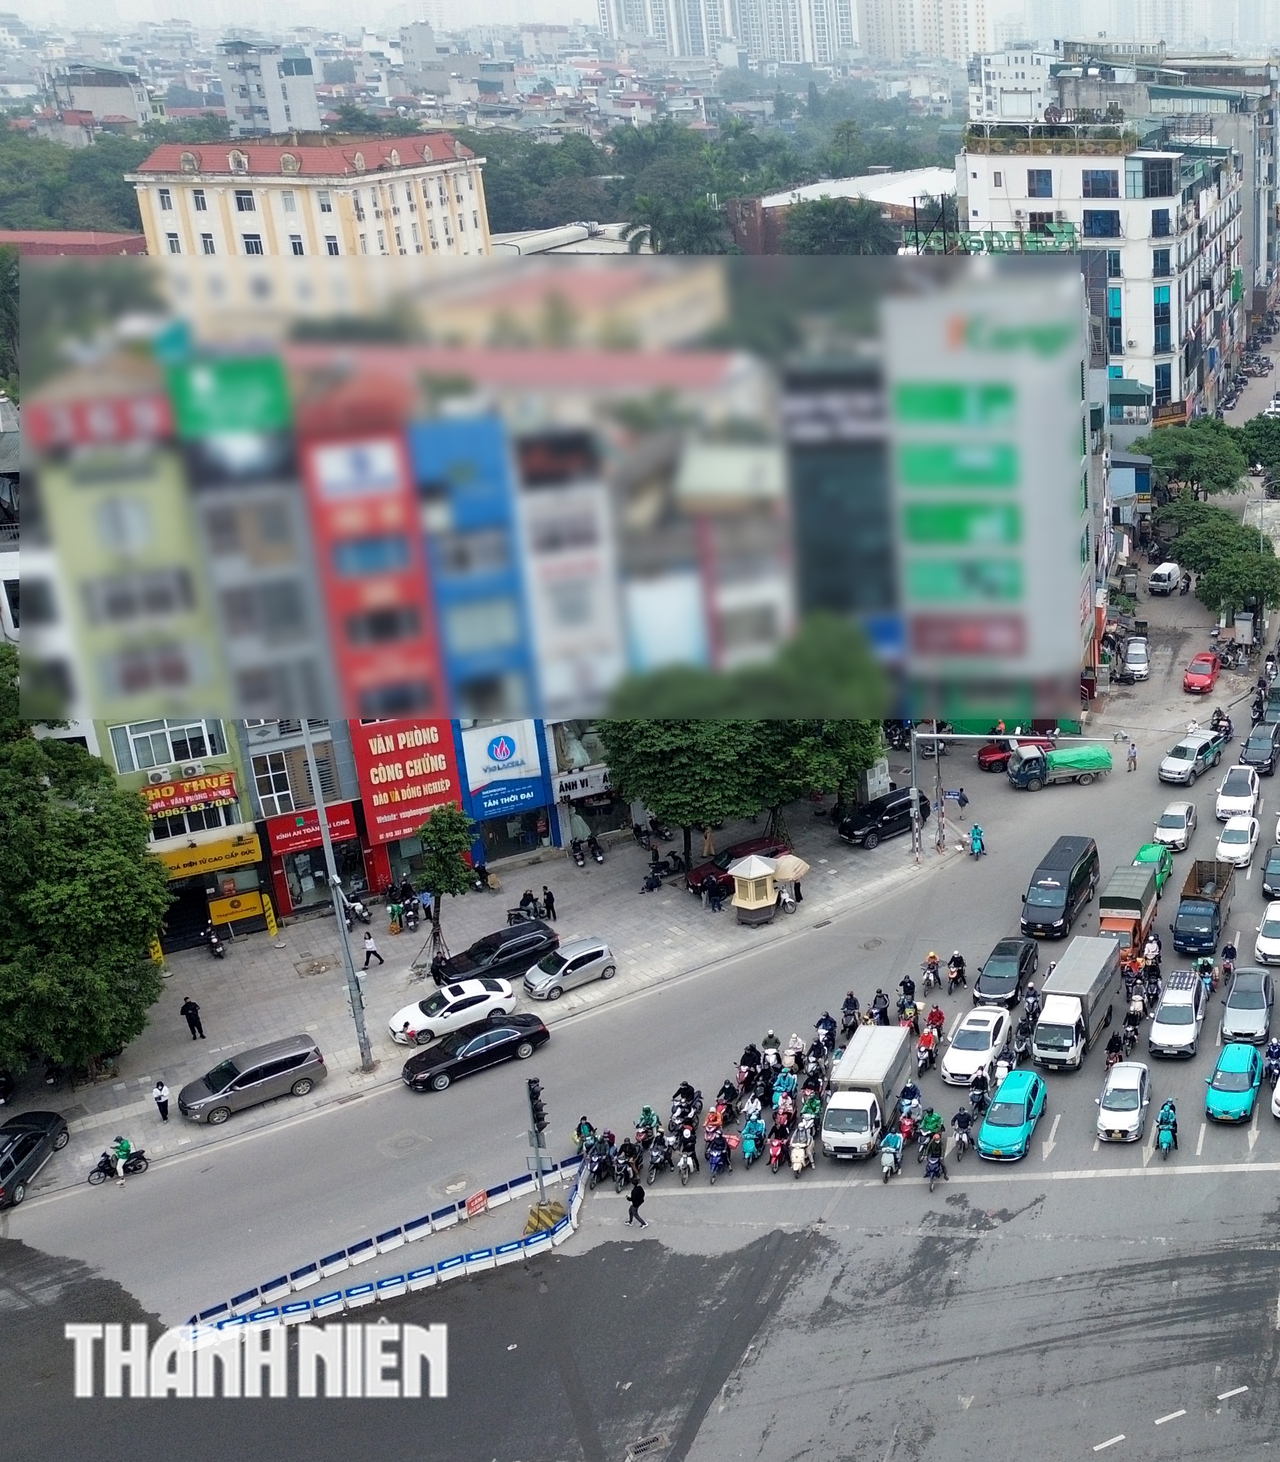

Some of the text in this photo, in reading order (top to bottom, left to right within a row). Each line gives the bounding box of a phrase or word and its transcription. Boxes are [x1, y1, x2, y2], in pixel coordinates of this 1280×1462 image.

[368, 725, 439, 756] VĂN PHÒNG
[369, 753, 447, 785] CÔNG CHỨNG
[180, 774, 232, 793] THUÊ
[389, 787, 401, 803] VÀ
[422, 778, 451, 795] NGHIỆP
[559, 780, 577, 794] ẢNH
[483, 799, 499, 809] TÂN
[500, 794, 519, 807] THỜI
[520, 790, 534, 801] ĐẠI
[276, 832, 292, 841] KÍNH
[292, 830, 302, 838] AN
[302, 824, 320, 836] TOÀN
[332, 819, 350, 828] LONG
[168, 861, 181, 871] OÁ
[207, 854, 224, 863] CAO
[224, 850, 239, 860] CẤP
